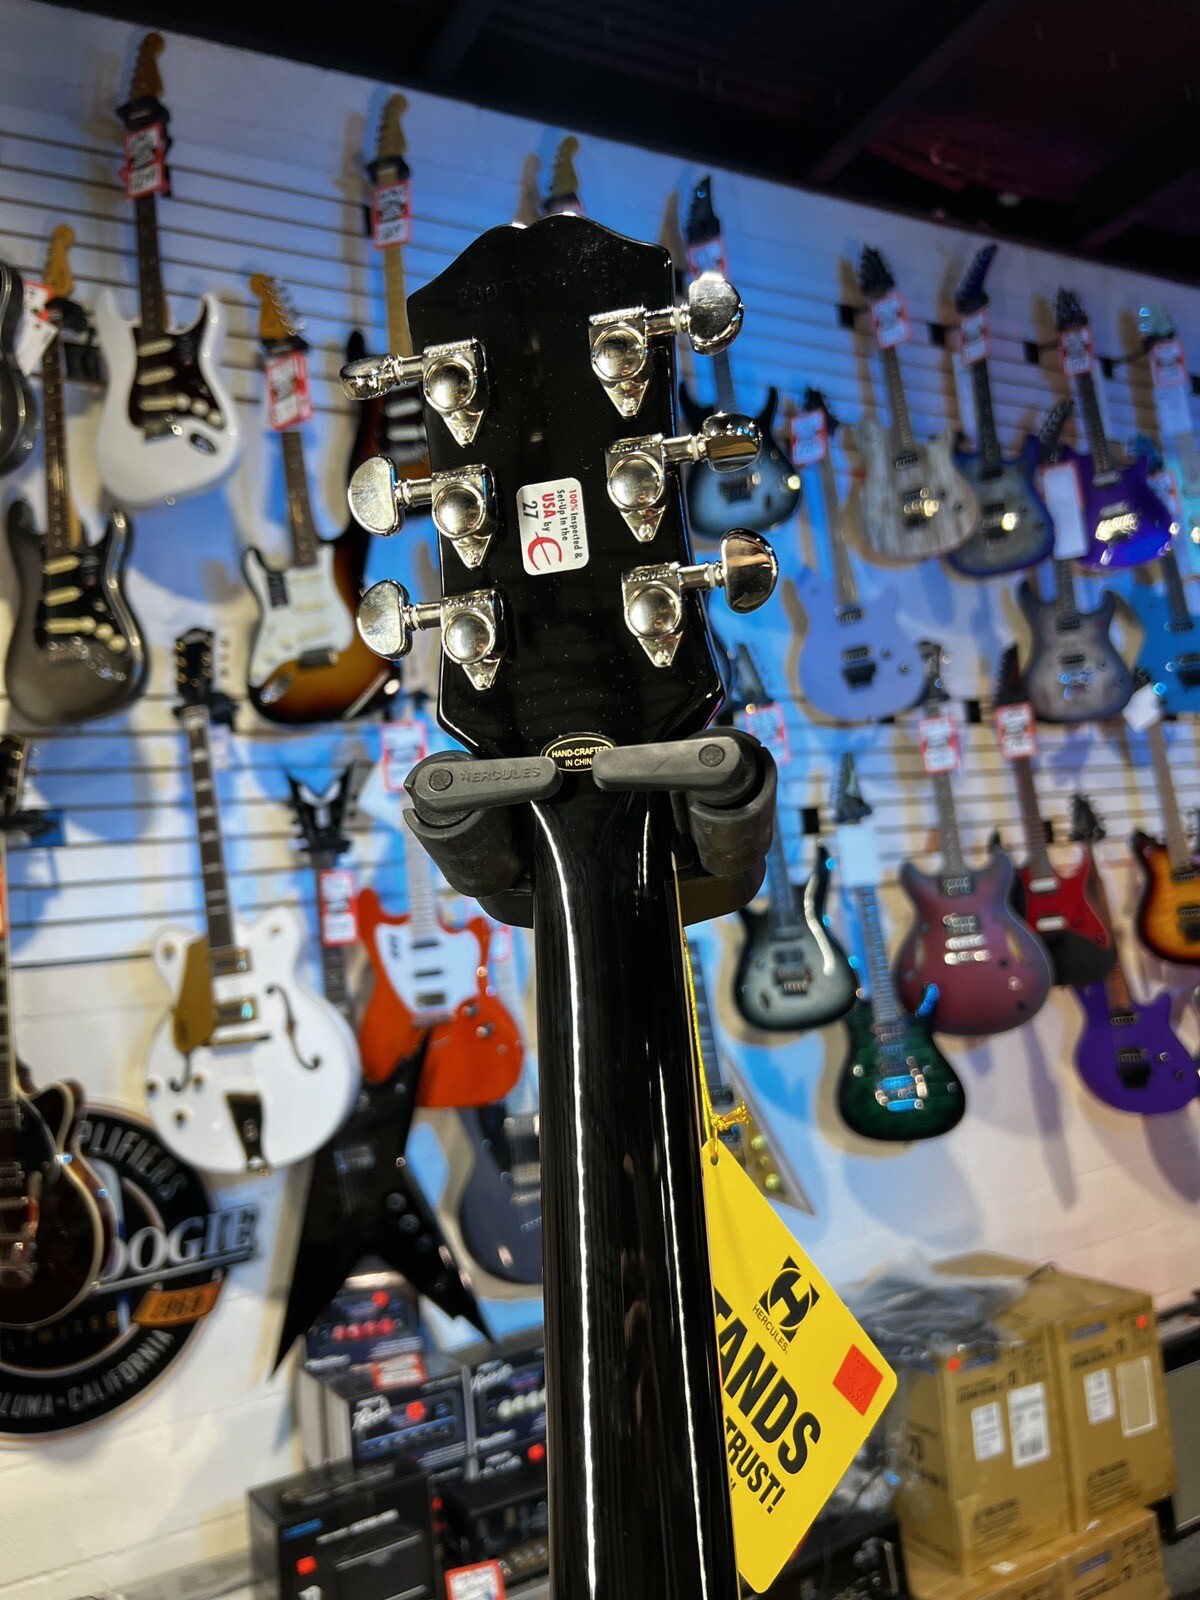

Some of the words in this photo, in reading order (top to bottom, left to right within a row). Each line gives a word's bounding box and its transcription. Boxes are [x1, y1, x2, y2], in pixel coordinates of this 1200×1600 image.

[522, 500, 540, 519] 27
[542, 493, 557, 518] USA
[557, 490, 567, 514] Set-Up
[569, 490, 579, 511] 100%
[541, 521, 552, 532] by
[561, 527, 570, 541] the
[570, 513, 582, 550] Inspected
[565, 759, 573, 767] IN
[574, 757, 592, 767] CHIN
[460, 766, 541, 783] HERCULES
[752, 1303, 789, 1353] HERCULES
[726, 1415, 787, 1514] TRUST!
